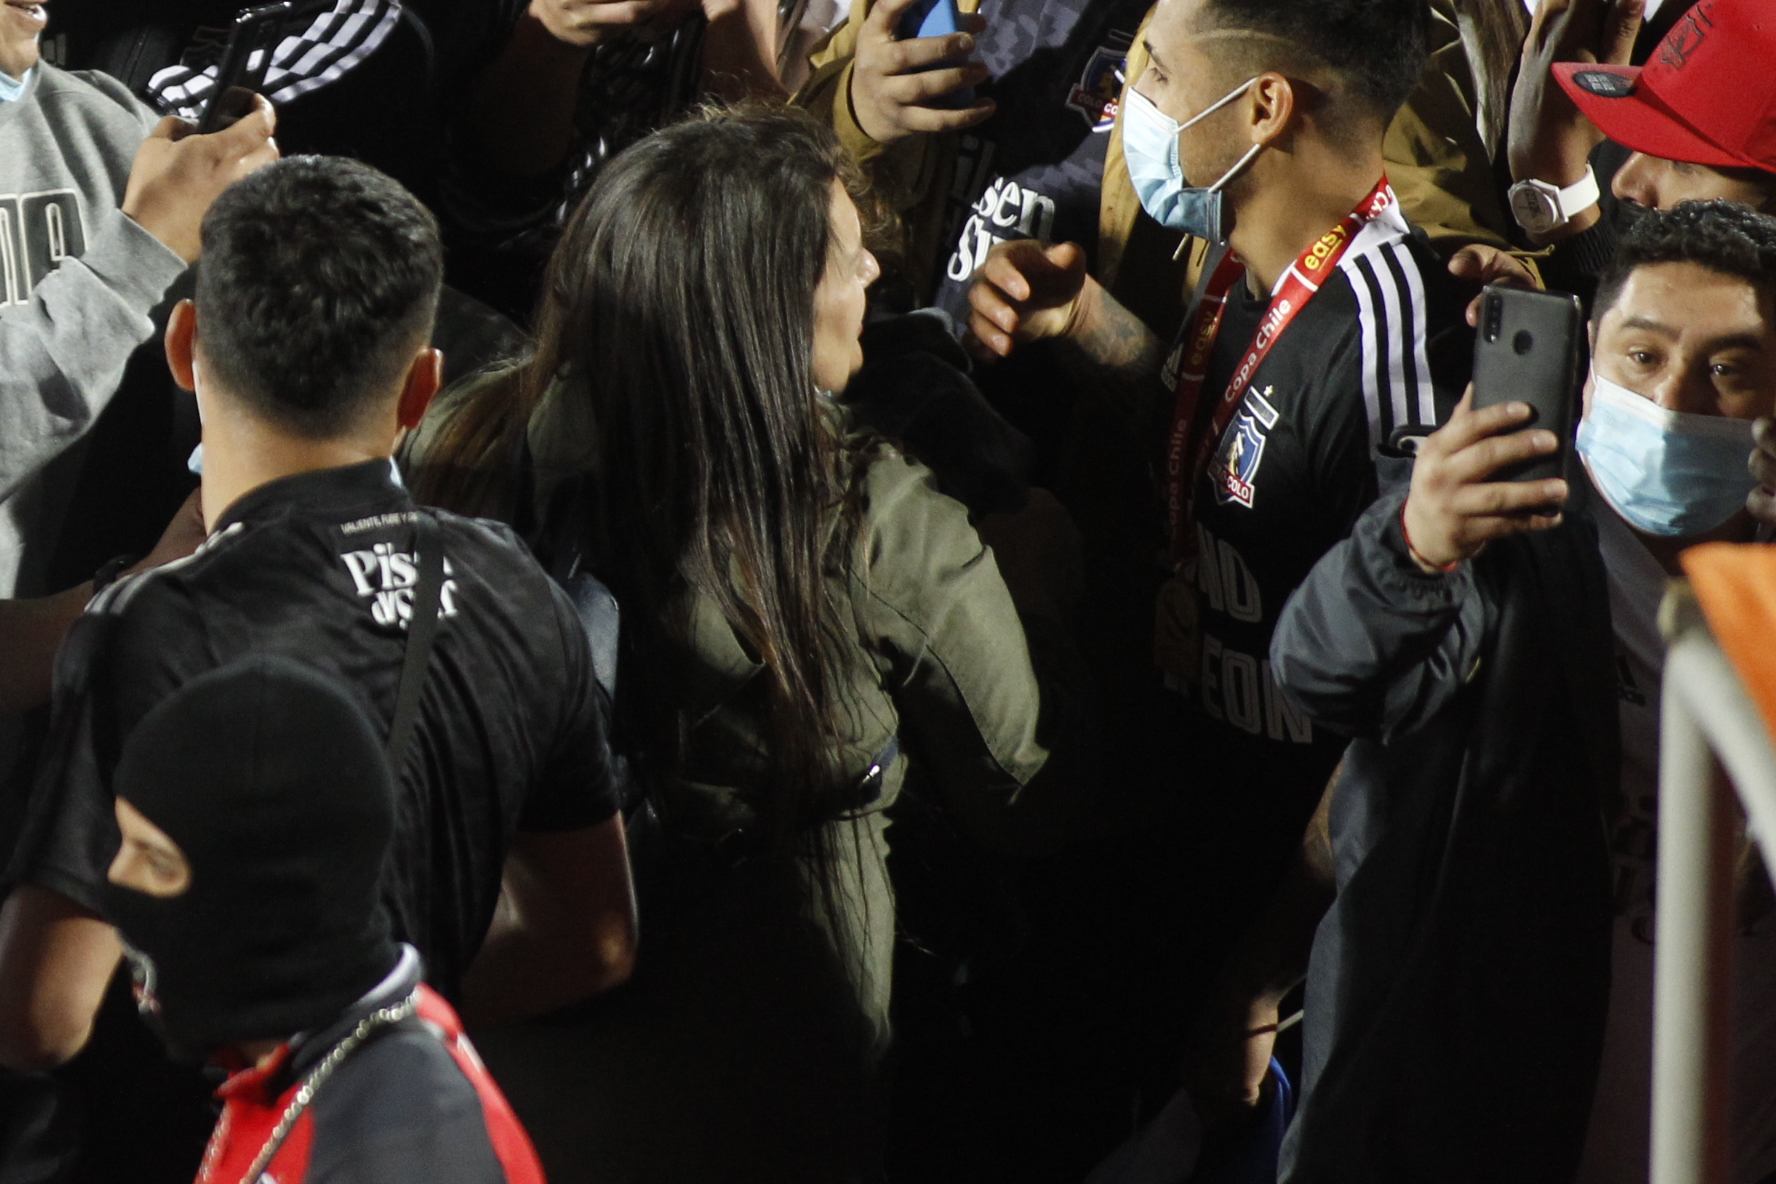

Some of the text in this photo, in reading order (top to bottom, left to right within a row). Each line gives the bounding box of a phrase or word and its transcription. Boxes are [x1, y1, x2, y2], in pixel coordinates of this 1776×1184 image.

[1304, 223, 1348, 270] easy
[1224, 297, 1292, 403] Copa Chile
